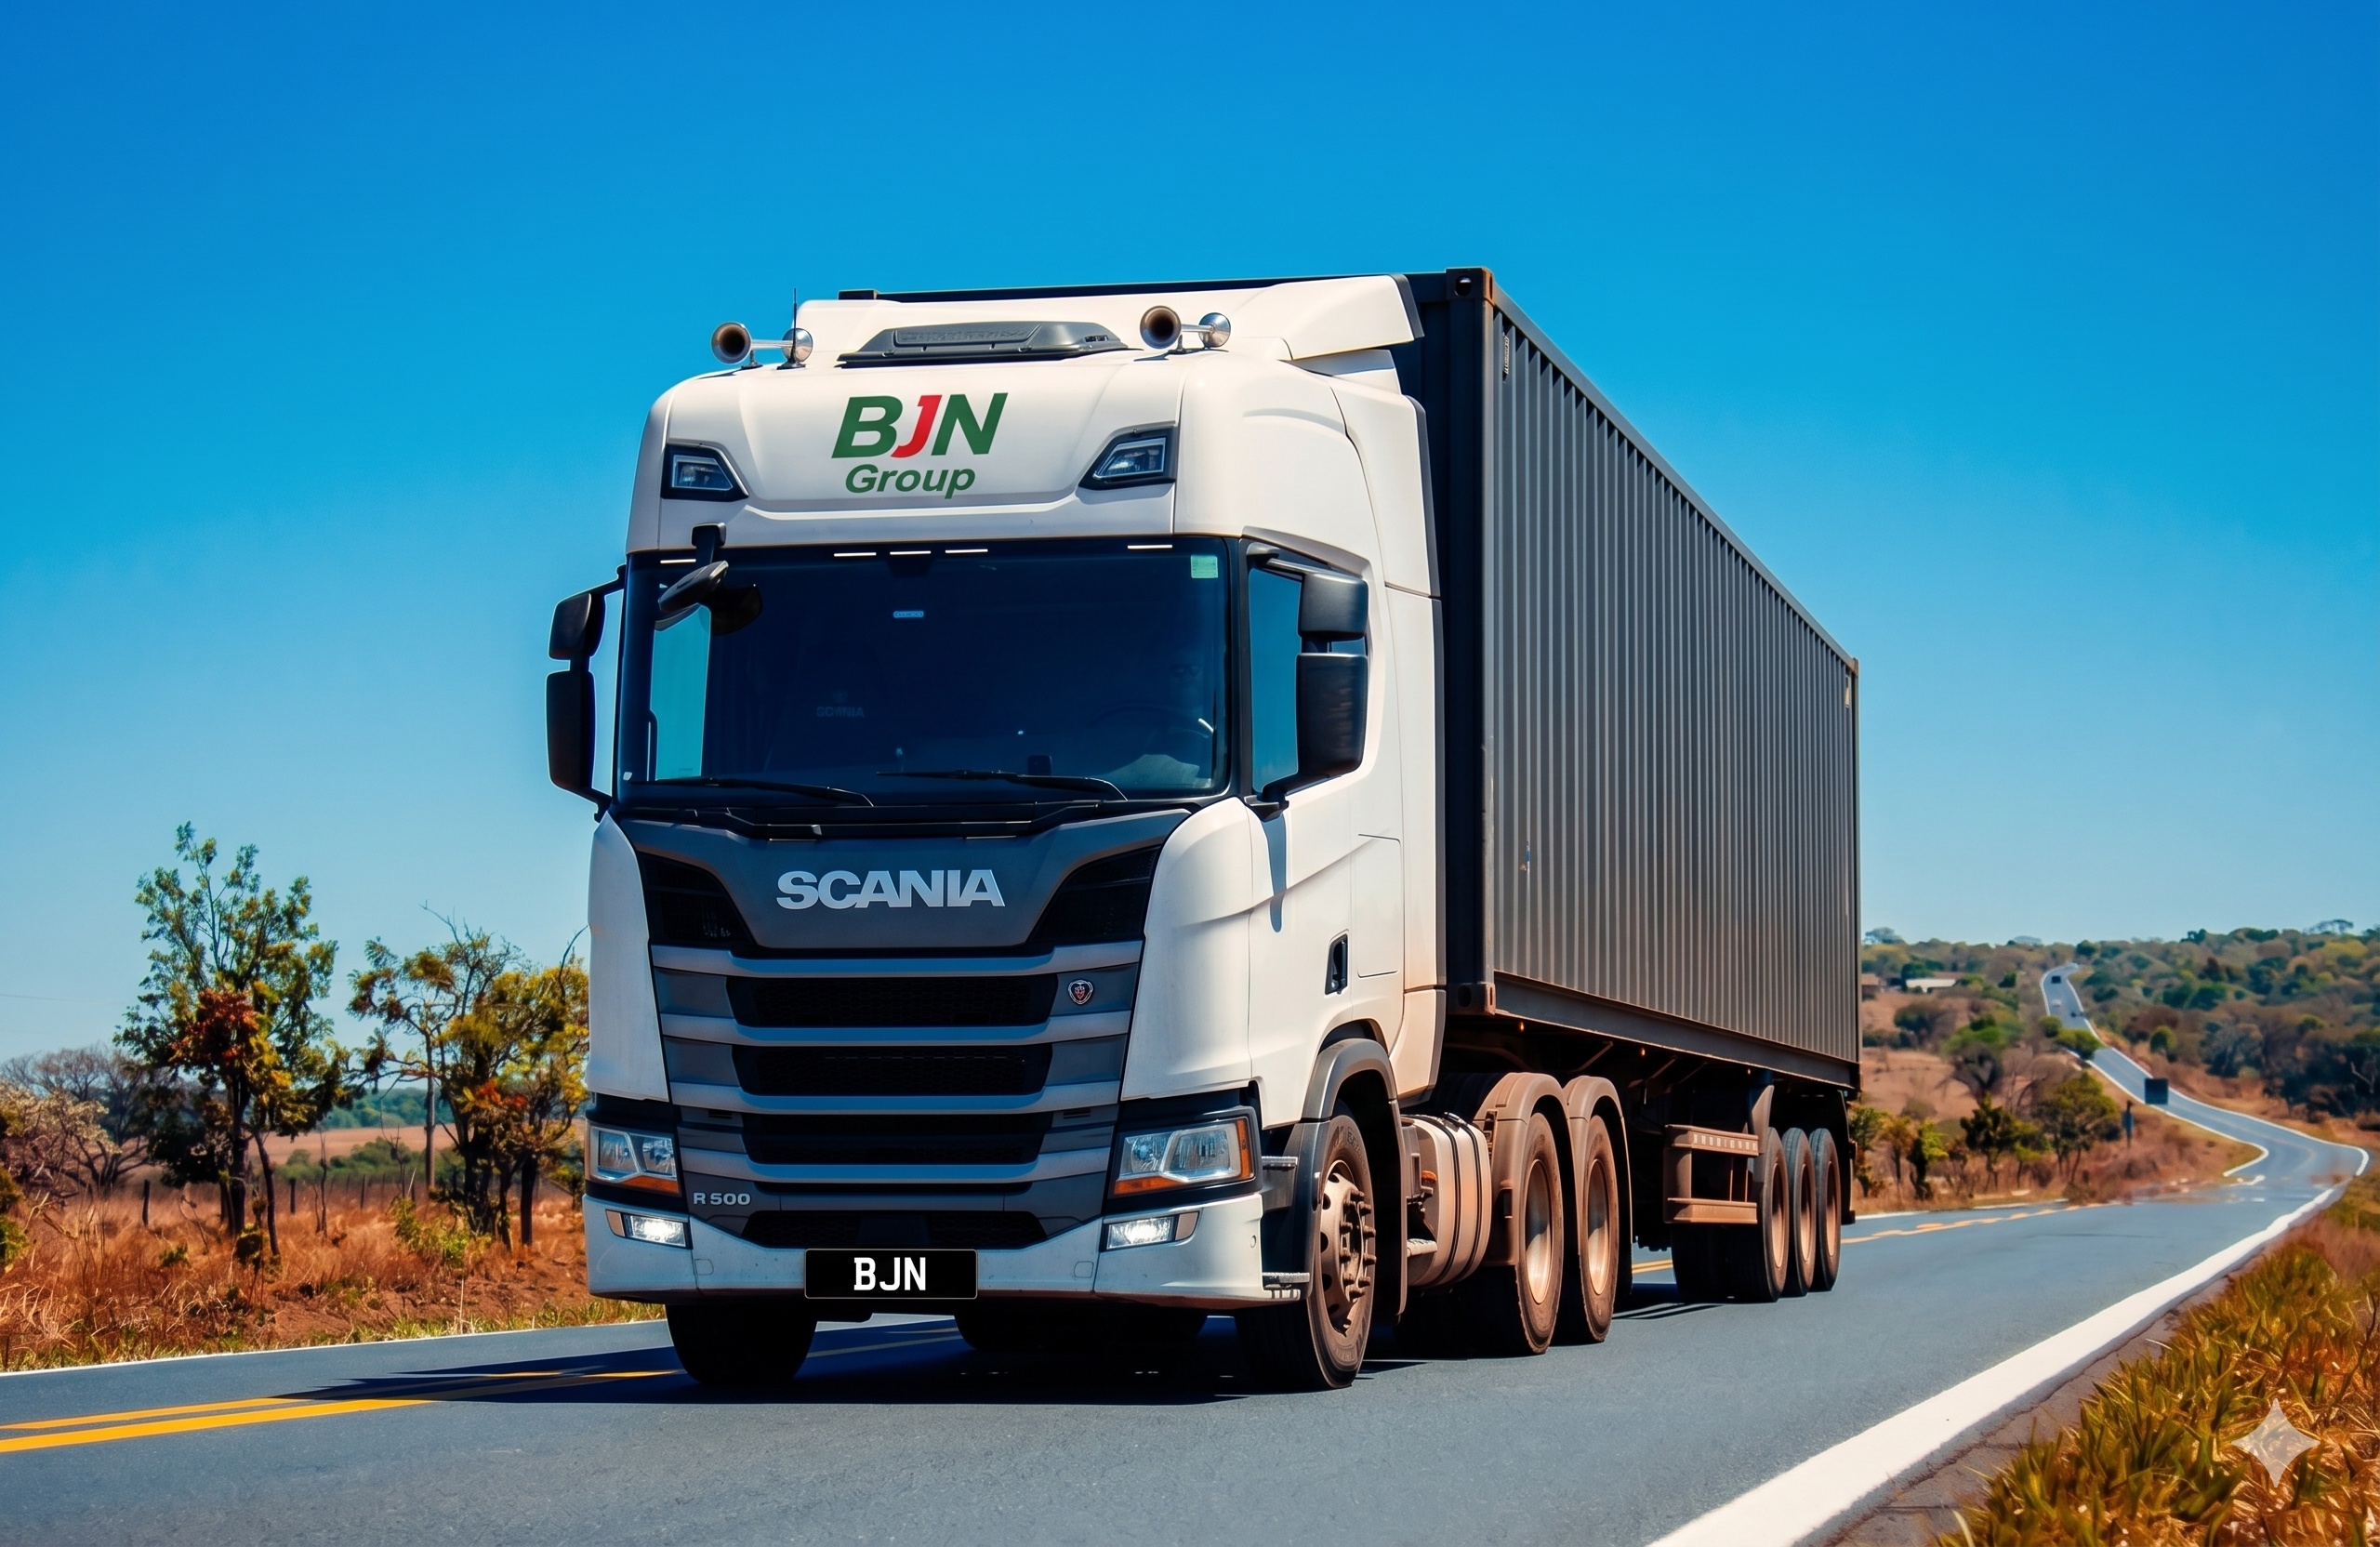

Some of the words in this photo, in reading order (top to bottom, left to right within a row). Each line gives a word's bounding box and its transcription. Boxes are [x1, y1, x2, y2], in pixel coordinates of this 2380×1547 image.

[831, 392, 1009, 458] BJN
[845, 464, 976, 499] Group
[776, 869, 1006, 909] SCANIA
[693, 1192, 707, 1205] R
[709, 1192, 751, 1206] 500
[853, 1257, 926, 1291] BJN
